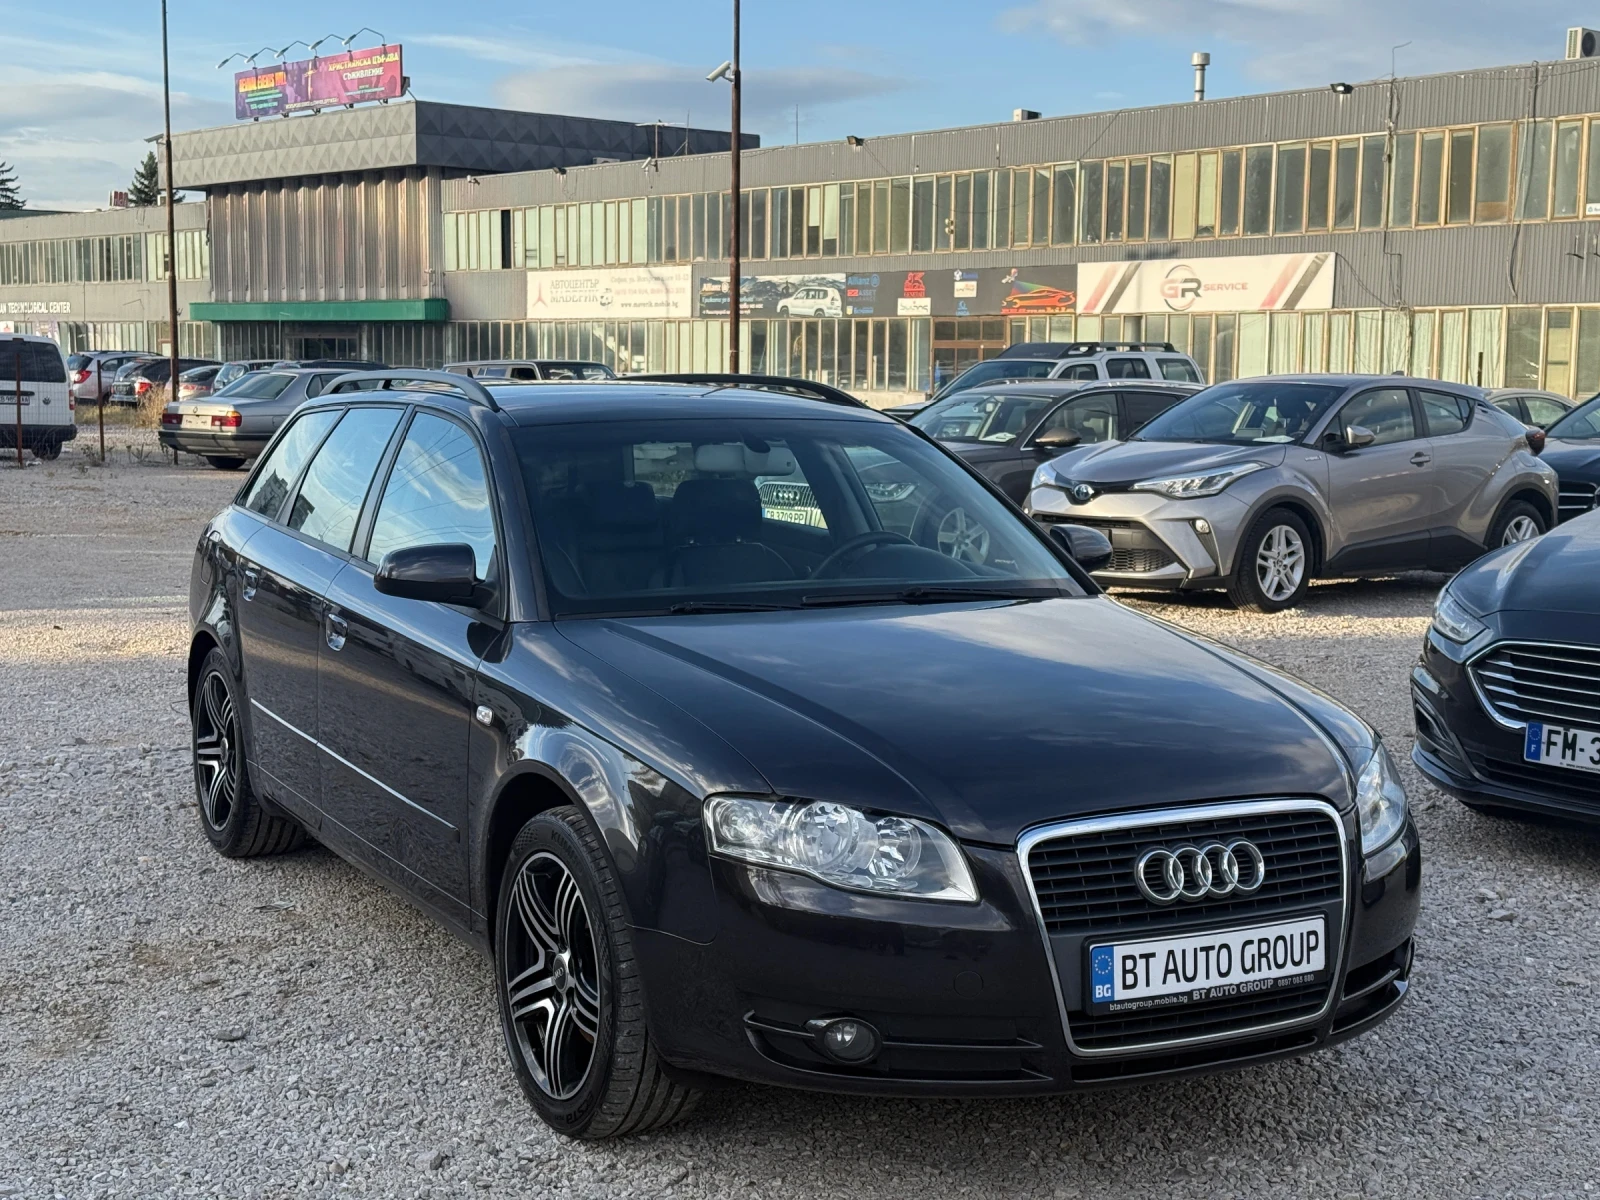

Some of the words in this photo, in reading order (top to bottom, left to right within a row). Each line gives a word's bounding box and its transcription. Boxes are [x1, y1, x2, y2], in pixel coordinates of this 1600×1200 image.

[550, 279, 600, 289] АВТОЦЕНТЪР
[847, 276, 870, 286] Allianz
[1160, 277, 1203, 299] GR
[1203, 282, 1248, 292] SERVICE
[50, 302, 71, 313] CENTER
[1530, 744, 1537, 753] F
[1121, 951, 1157, 991] BT
[1161, 942, 1233, 986] AUTO
[1240, 929, 1320, 975] GROUP
[1095, 984, 1112, 998] BG
[1109, 995, 1188, 1011] btautogroup.mobile.bg
[1192, 989, 1207, 1001] BT
[1209, 984, 1237, 999] AUTO
[1239, 979, 1274, 994] GROUP
